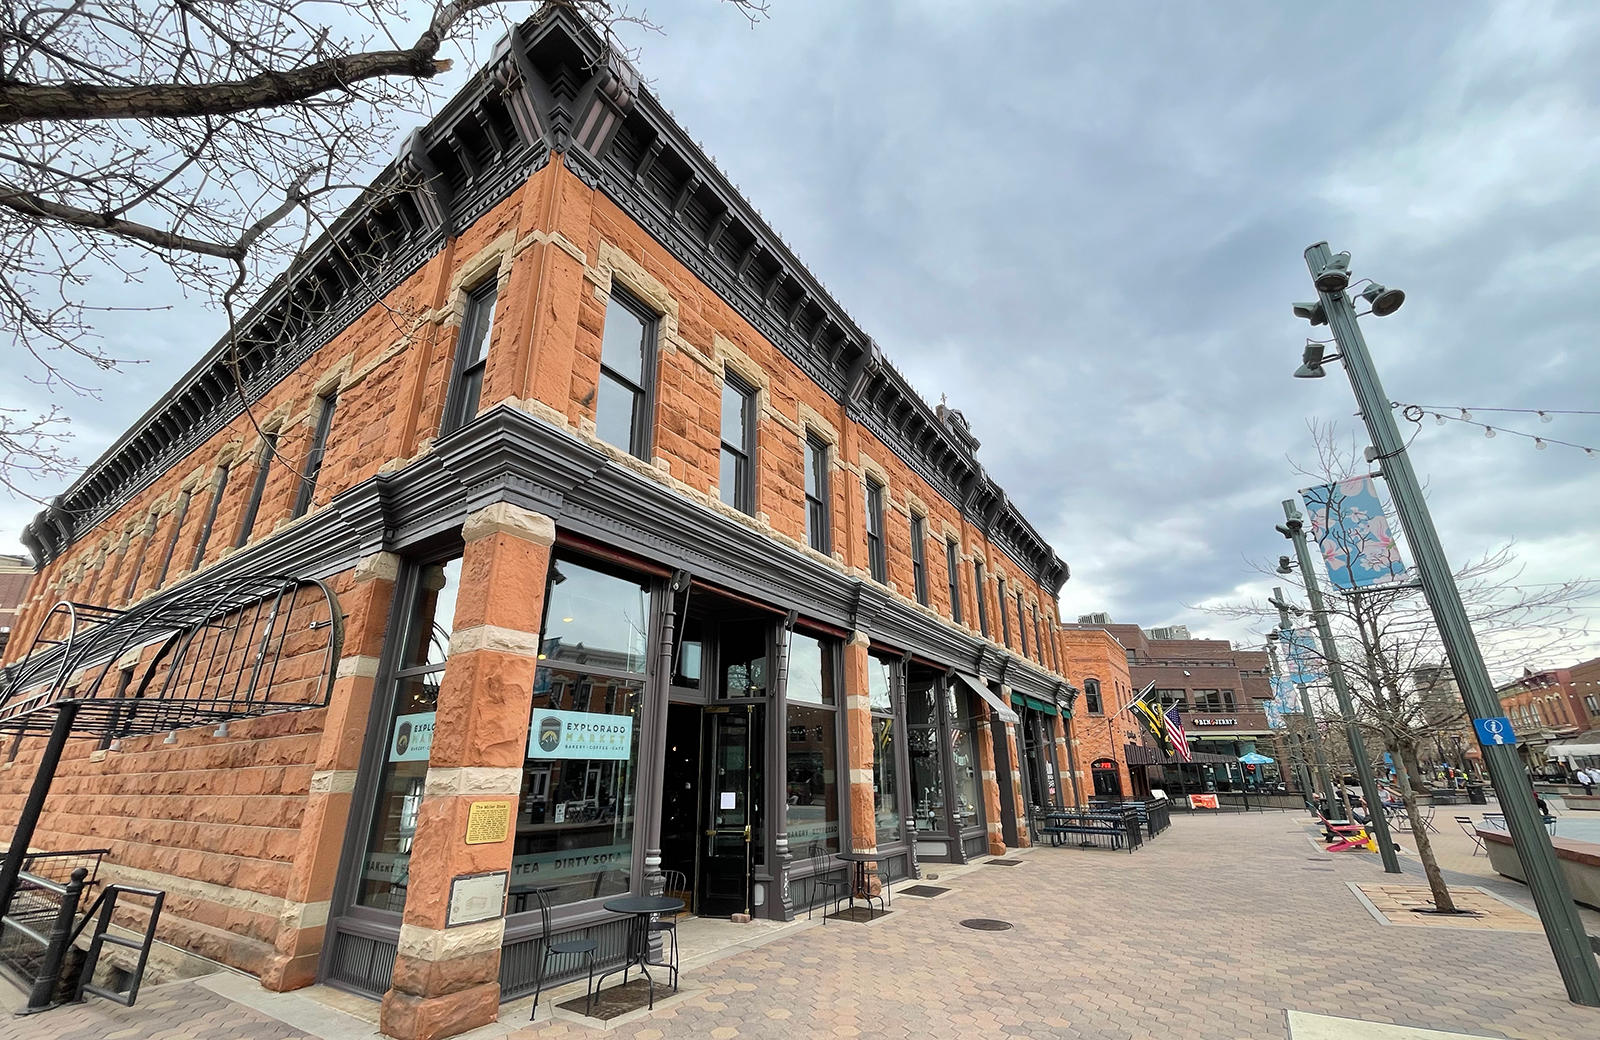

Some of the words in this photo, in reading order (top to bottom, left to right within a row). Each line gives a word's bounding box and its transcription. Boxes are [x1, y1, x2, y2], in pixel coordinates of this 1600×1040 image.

[566, 723, 626, 734] EXPLORADO
[565, 733, 625, 744] MARKET
[514, 862, 540, 875] TEA
[554, 856, 590, 870] DIRTY
